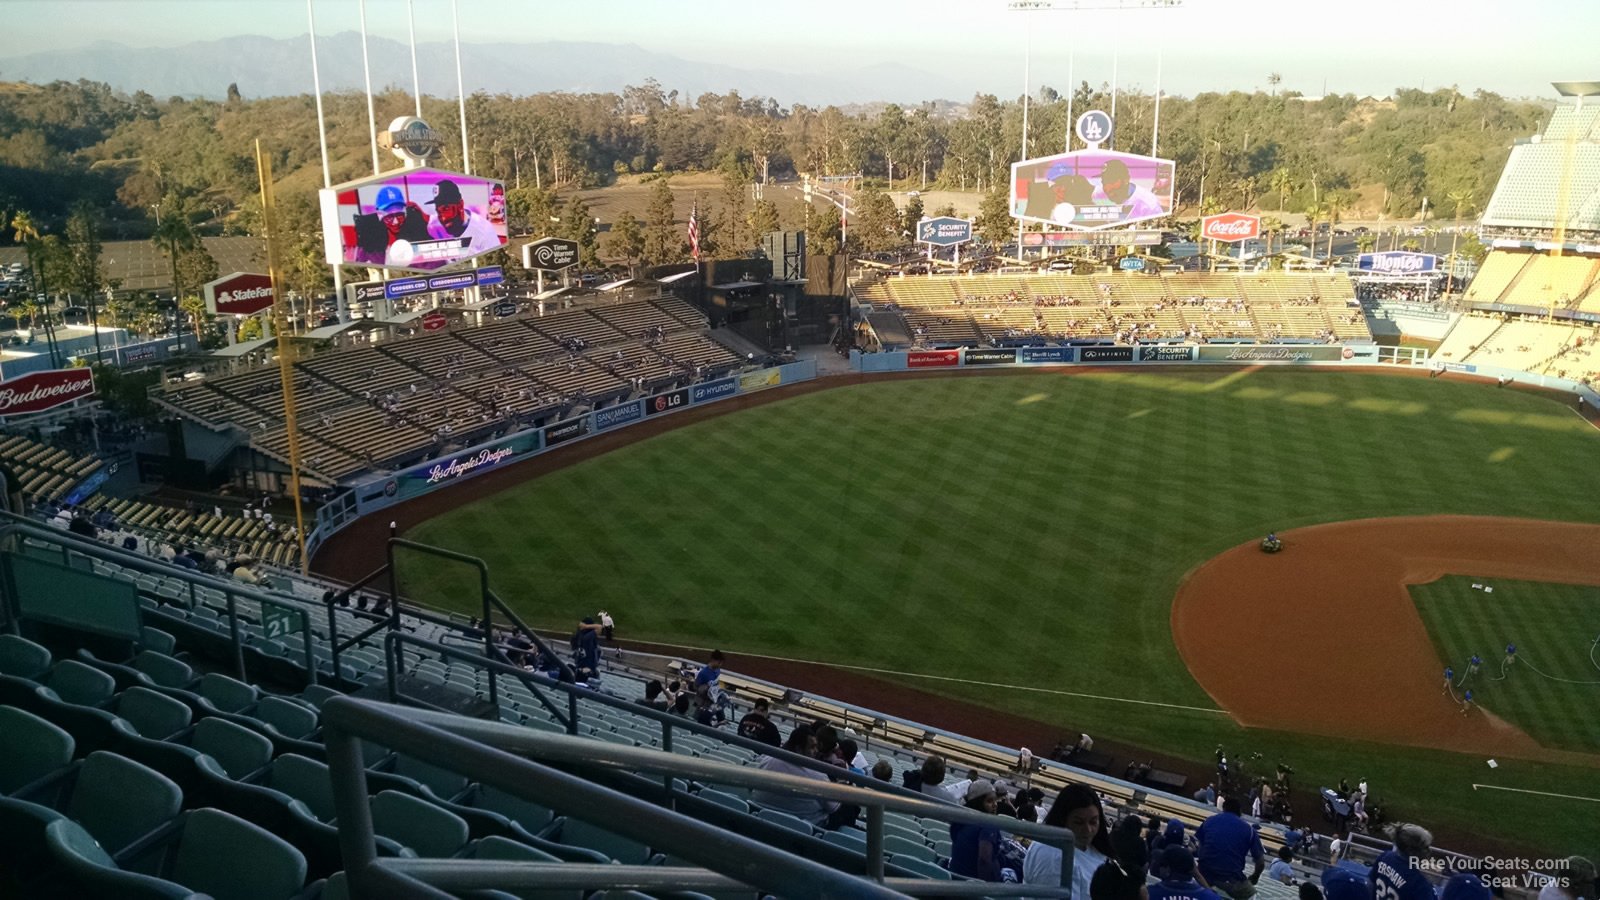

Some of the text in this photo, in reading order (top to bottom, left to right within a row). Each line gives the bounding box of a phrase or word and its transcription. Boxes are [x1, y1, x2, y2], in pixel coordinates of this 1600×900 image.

[1086, 115, 1103, 139] LA
[938, 224, 968, 232] SECURITY
[553, 244, 569, 252] Time
[553, 250, 575, 258] Warner
[553, 257, 572, 265] Cable
[1371, 254, 1424, 272] Montejo
[1226, 347, 1313, 362] Los Angeles Dodgers
[0, 379, 91, 409] Budweiser
[706, 383, 737, 395] HYUNDAI
[668, 394, 681, 406] LG
[614, 404, 639, 418] MANUEL
[426, 446, 514, 483] Los Angeles Dodgers
[267, 616, 290, 638] 21
